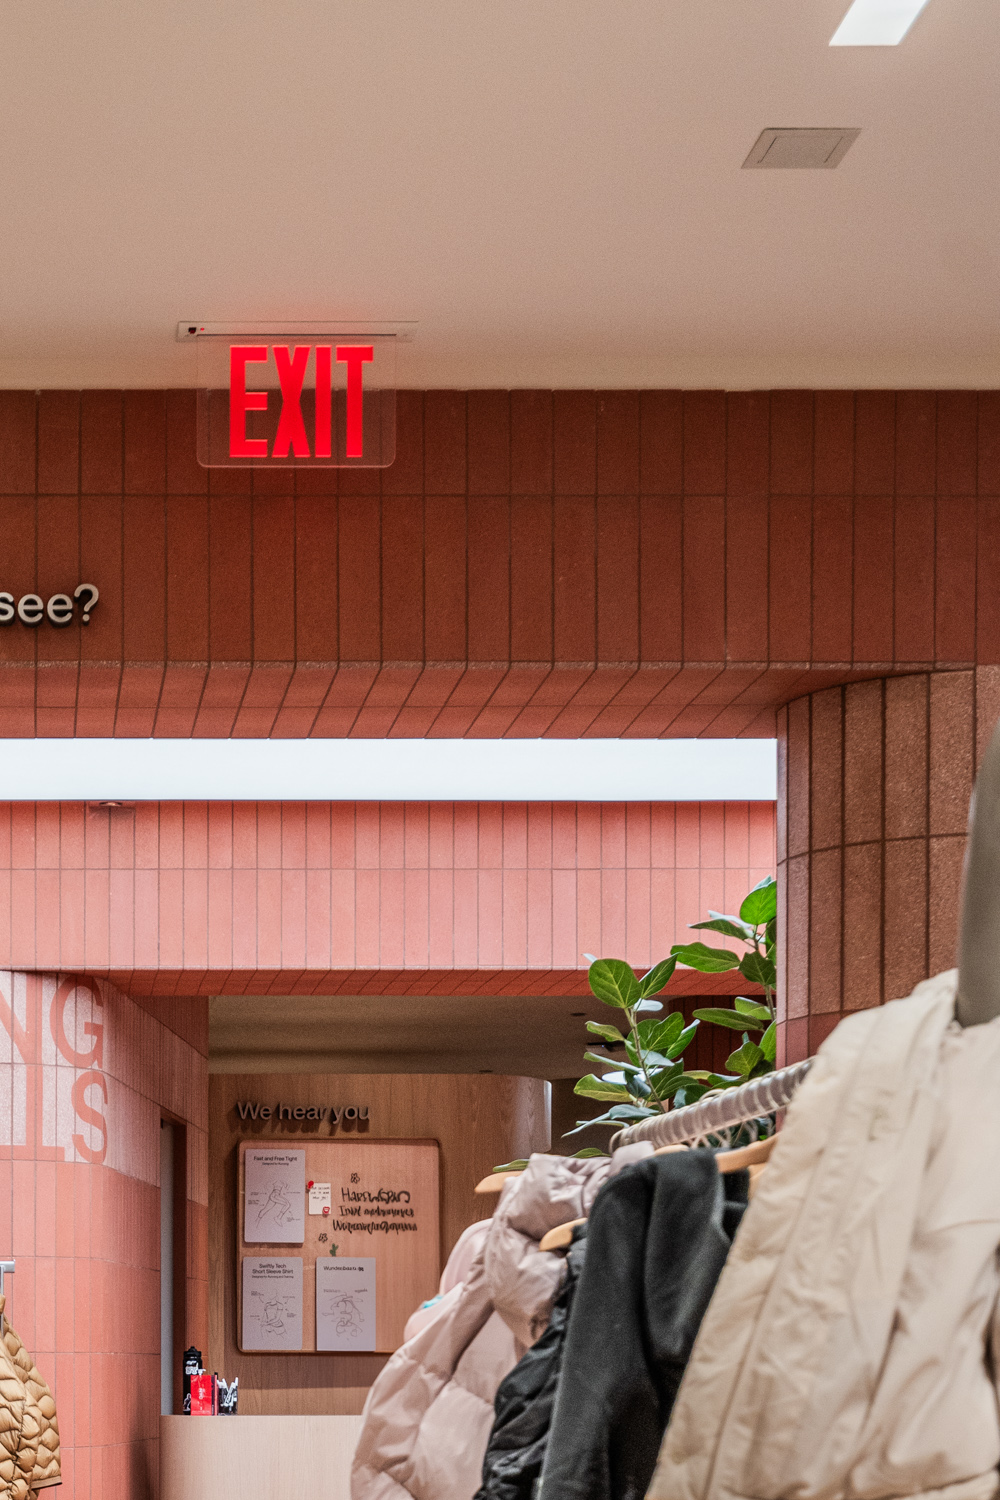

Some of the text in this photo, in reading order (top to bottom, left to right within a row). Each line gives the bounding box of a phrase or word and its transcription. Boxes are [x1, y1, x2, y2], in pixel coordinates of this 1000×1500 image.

[229, 344, 374, 458] EXIT
[237, 1101, 370, 1125] We hear you
